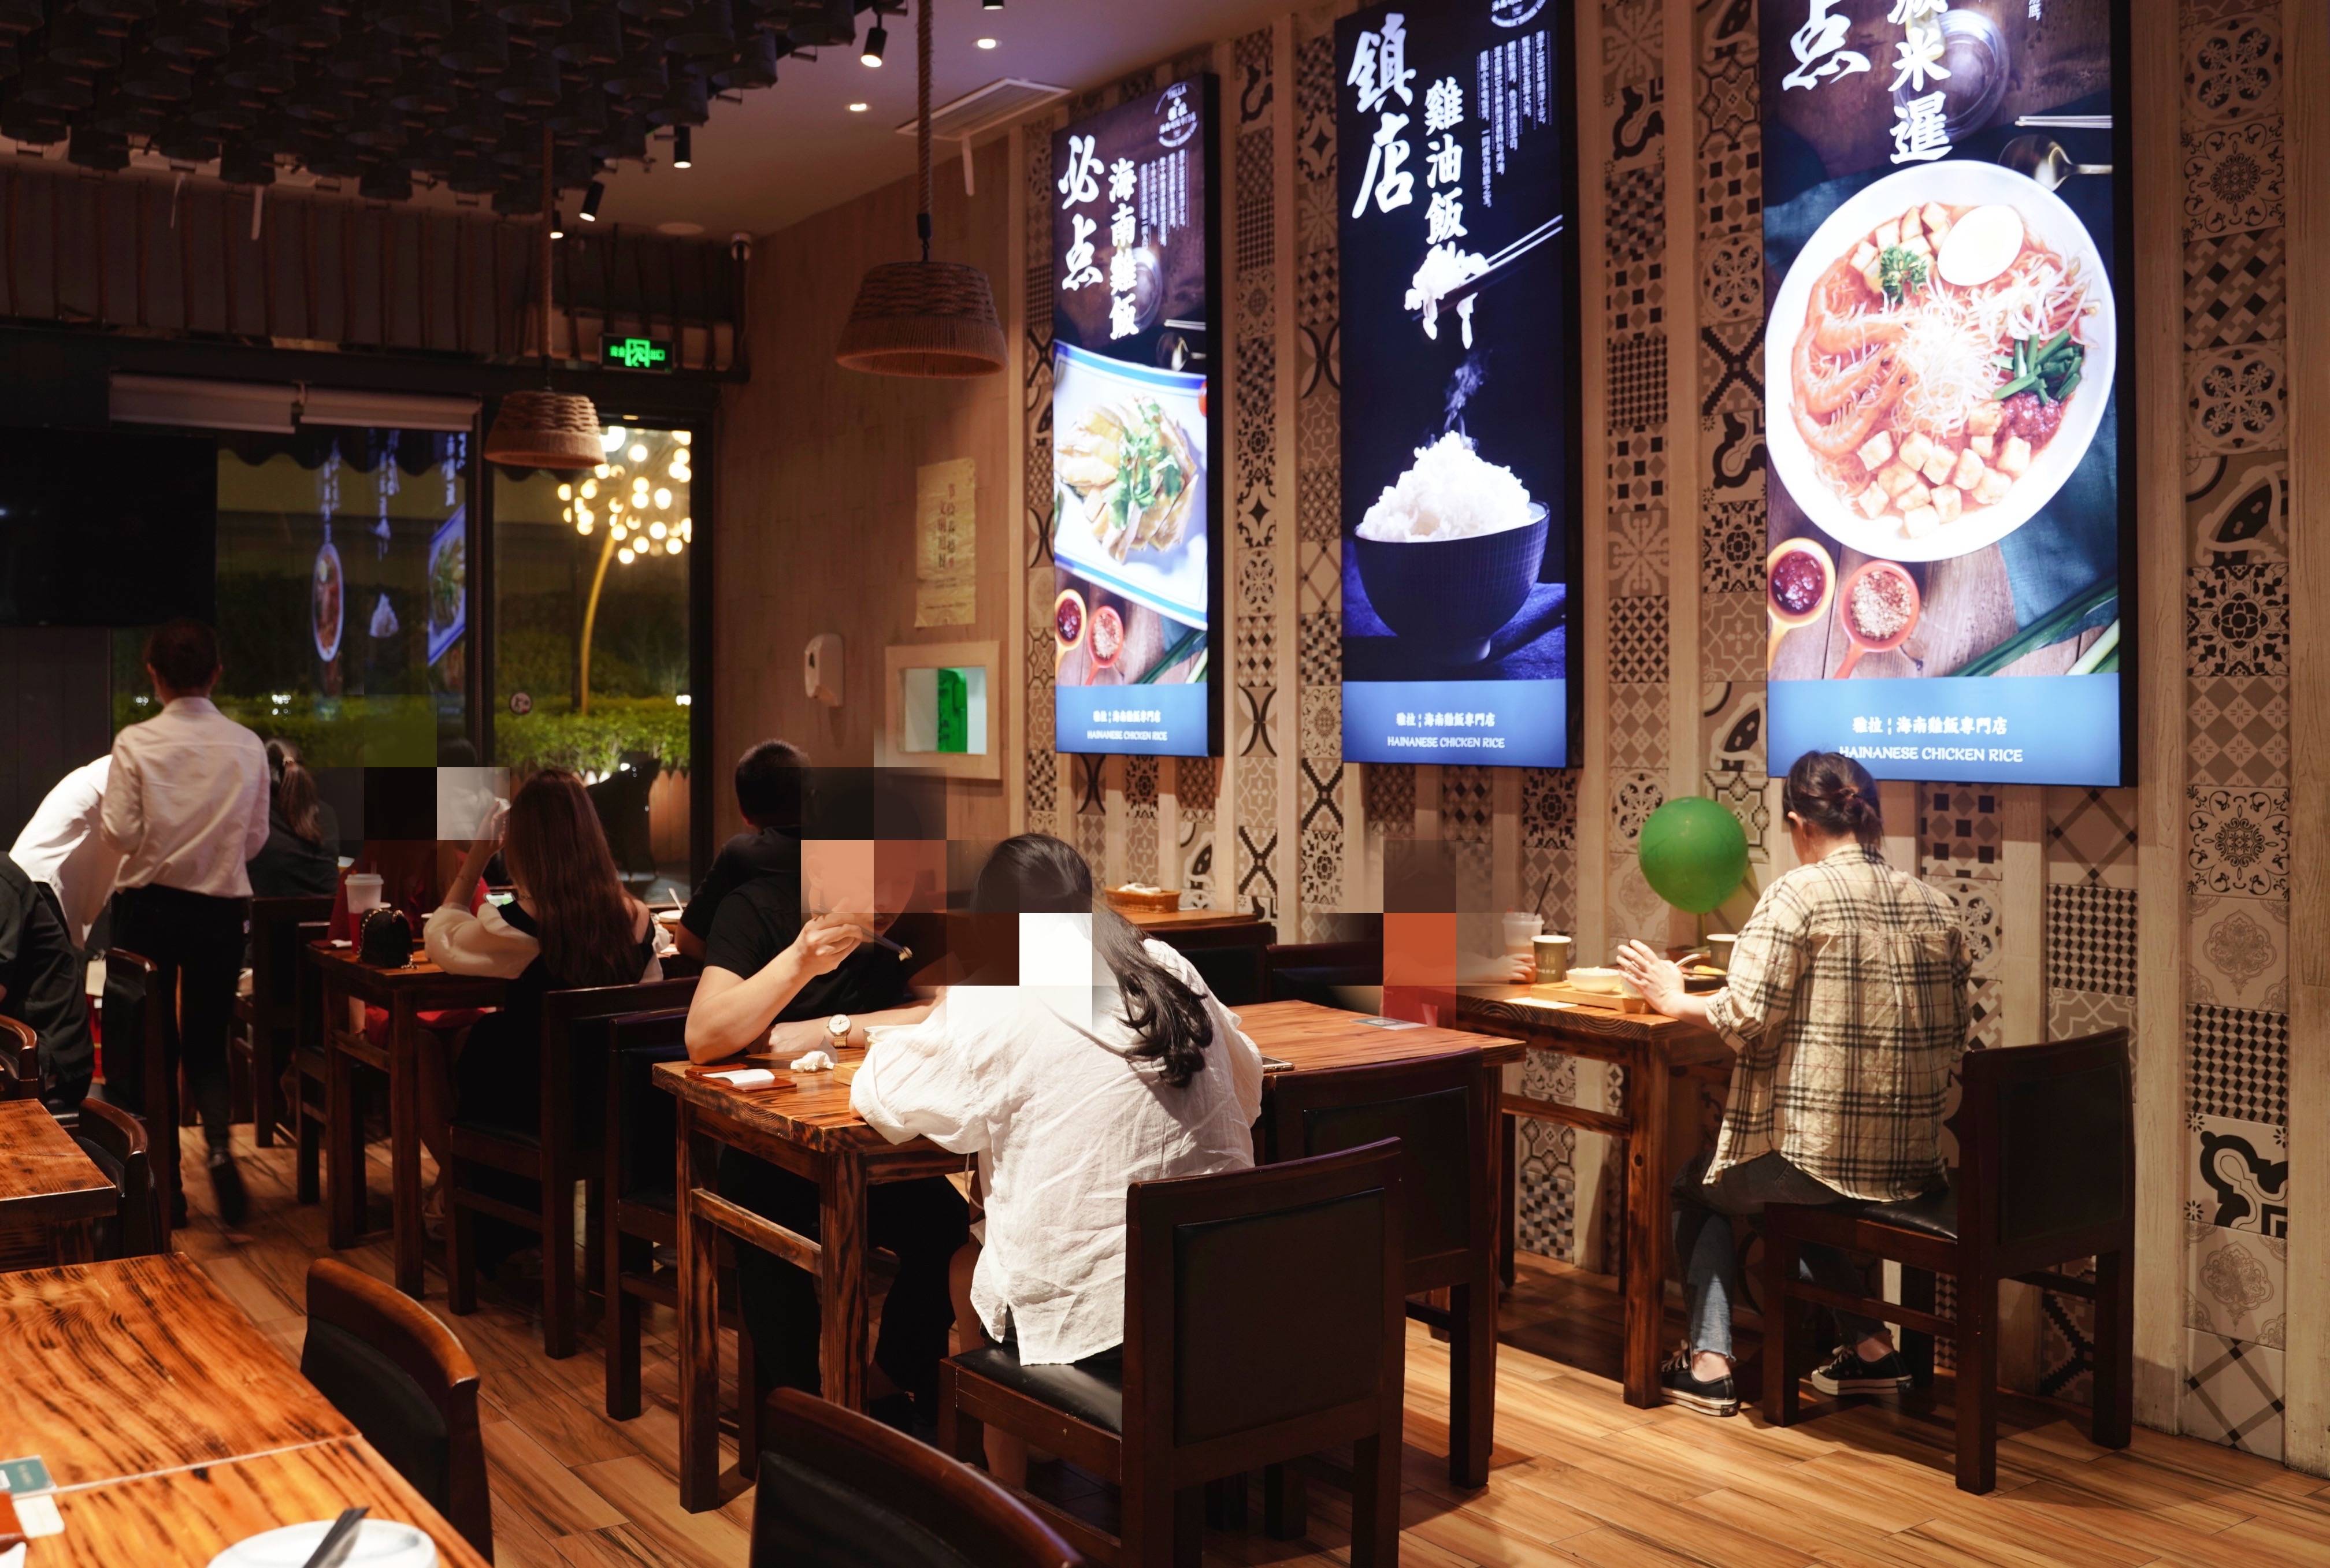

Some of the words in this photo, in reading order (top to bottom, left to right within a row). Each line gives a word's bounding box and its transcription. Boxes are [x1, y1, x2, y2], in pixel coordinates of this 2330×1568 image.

[1347, 13, 1416, 218] 鎮店
[1424, 76, 1468, 245] 雞油飯
[1058, 135, 1104, 291] 必点
[1108, 158, 1139, 340] 海南雞飯
[1387, 736, 1438, 748] HAINANESE
[1439, 737, 1481, 748] CHICKEN
[1482, 737, 1505, 749] RICE
[1839, 746, 1919, 760] HAINANESE
[1921, 746, 1985, 761] CHICKEN
[1988, 748, 2023, 762] RICE
